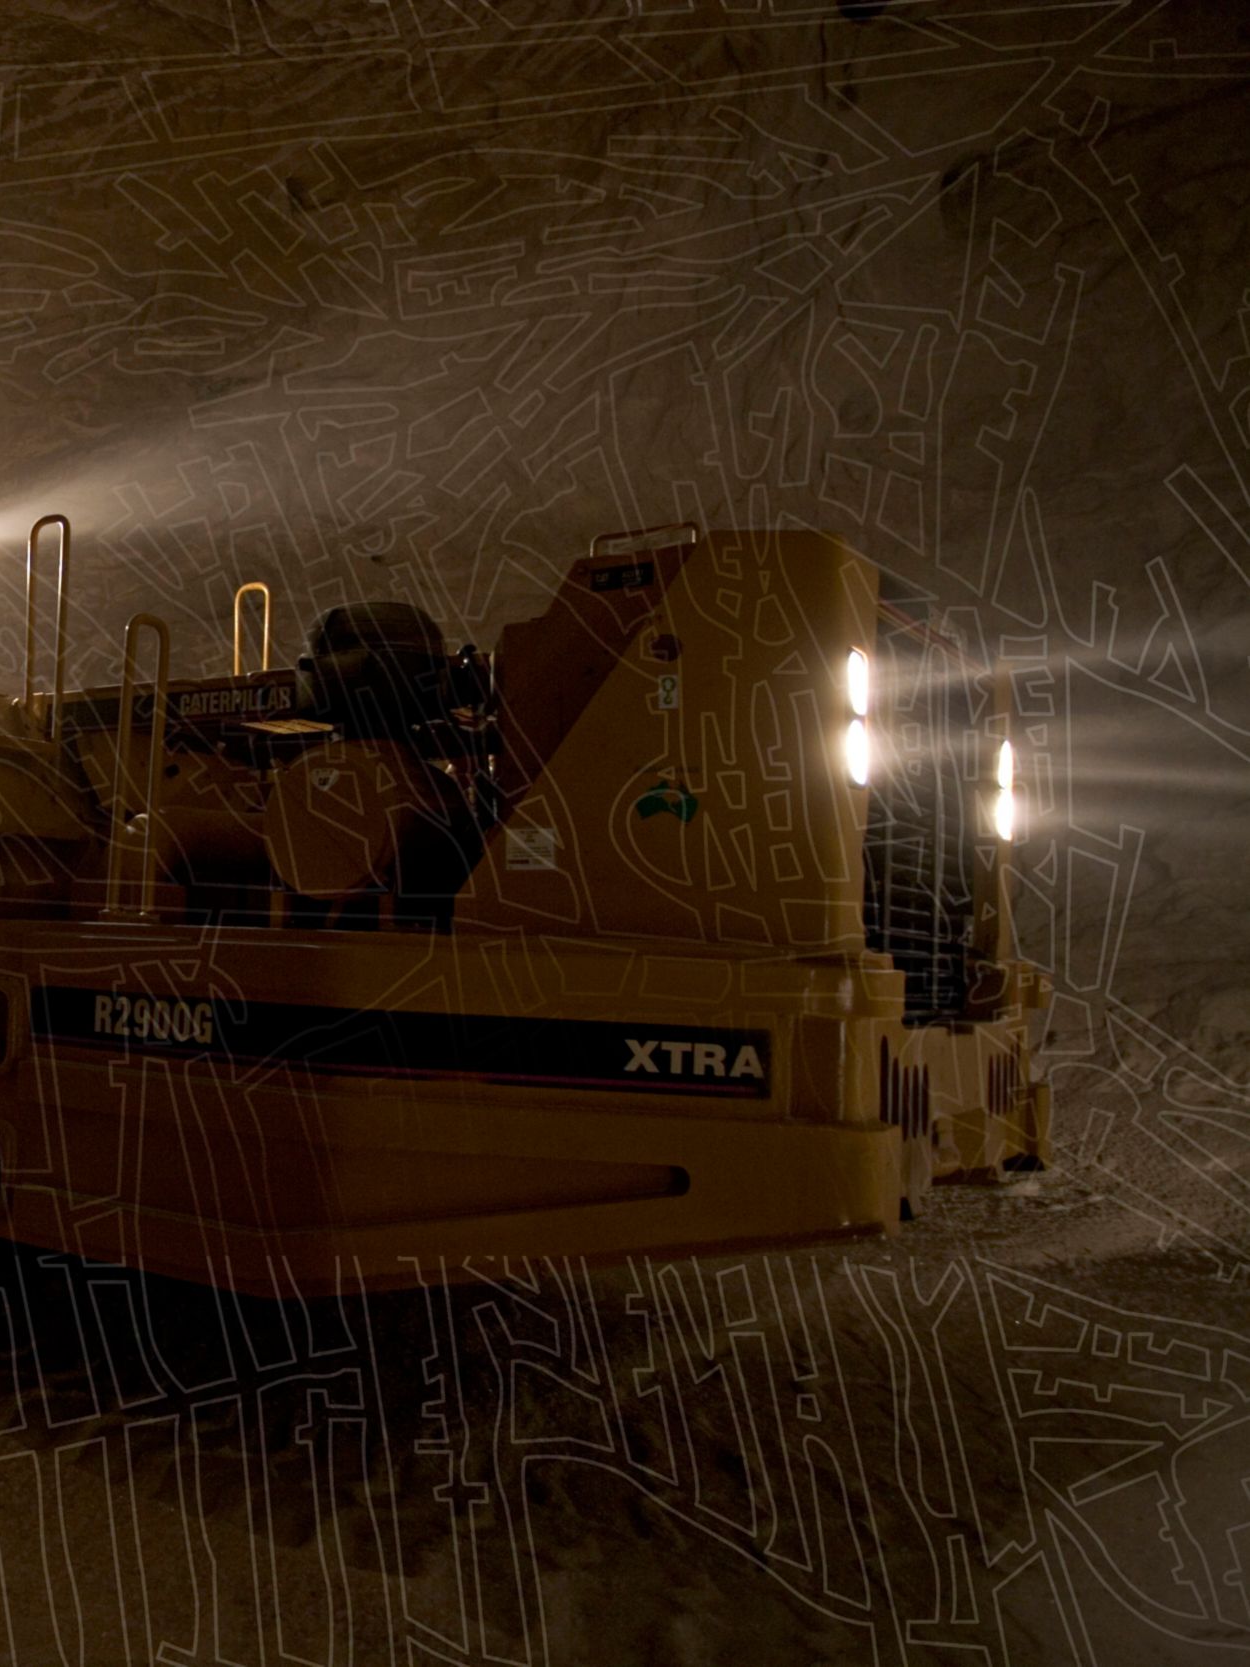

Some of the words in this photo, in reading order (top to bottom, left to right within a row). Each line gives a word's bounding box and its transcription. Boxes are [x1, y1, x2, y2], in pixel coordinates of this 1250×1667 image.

[180, 686, 292, 716] CATERPILLAR
[94, 995, 214, 1044] R2900G
[622, 1038, 766, 1079] XTRA
